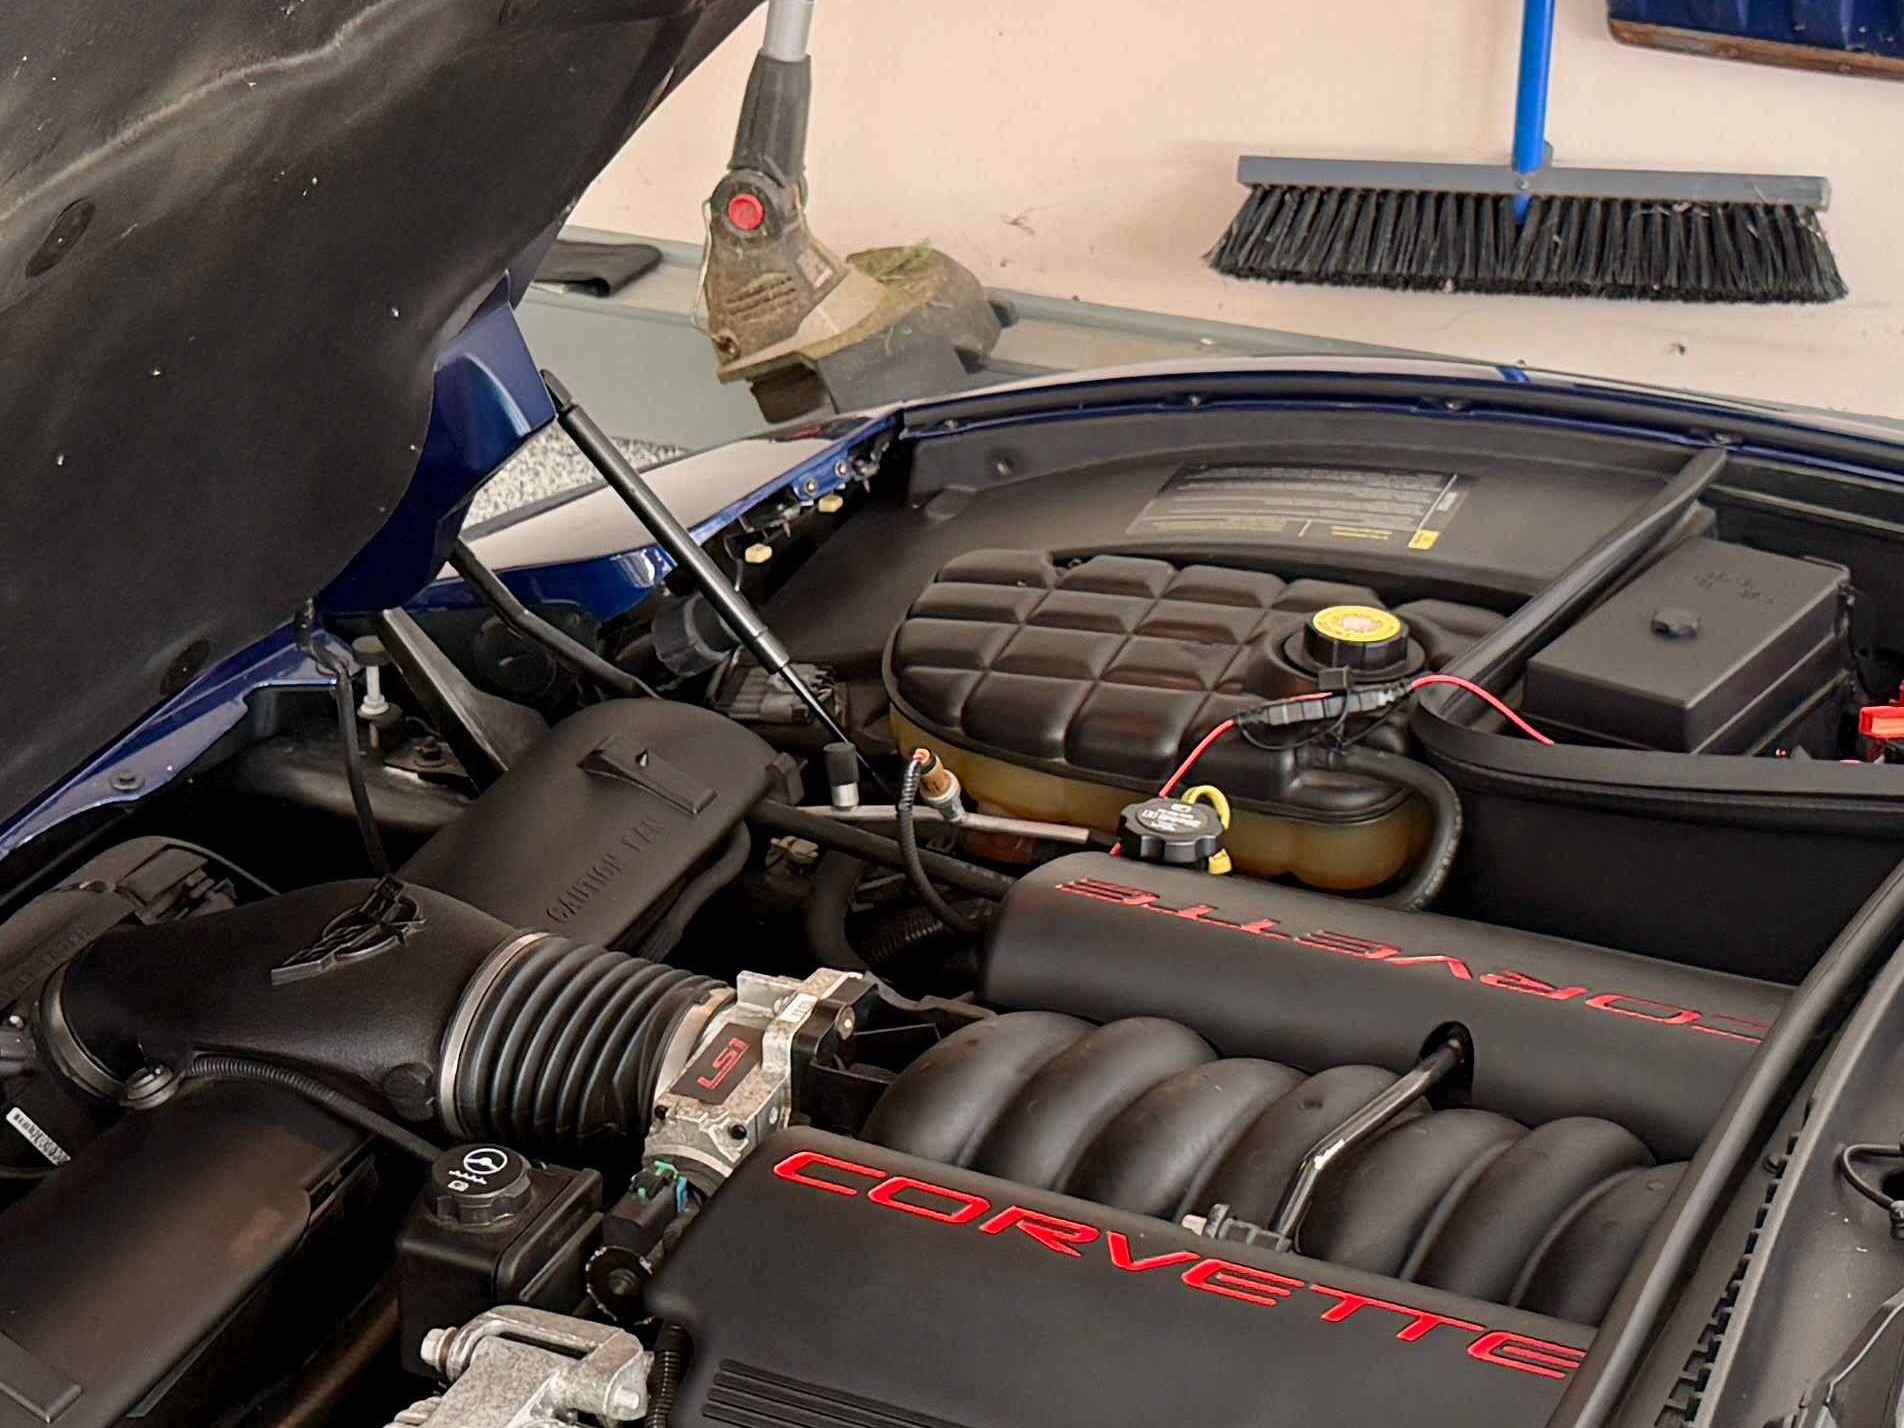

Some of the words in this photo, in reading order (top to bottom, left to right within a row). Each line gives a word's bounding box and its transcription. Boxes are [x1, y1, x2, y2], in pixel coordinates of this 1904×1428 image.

[546, 851, 624, 924] CAUTION
[622, 813, 665, 854] FAN
[696, 1036, 752, 1091] LS1
[773, 1147, 1588, 1380] CORVETTE
